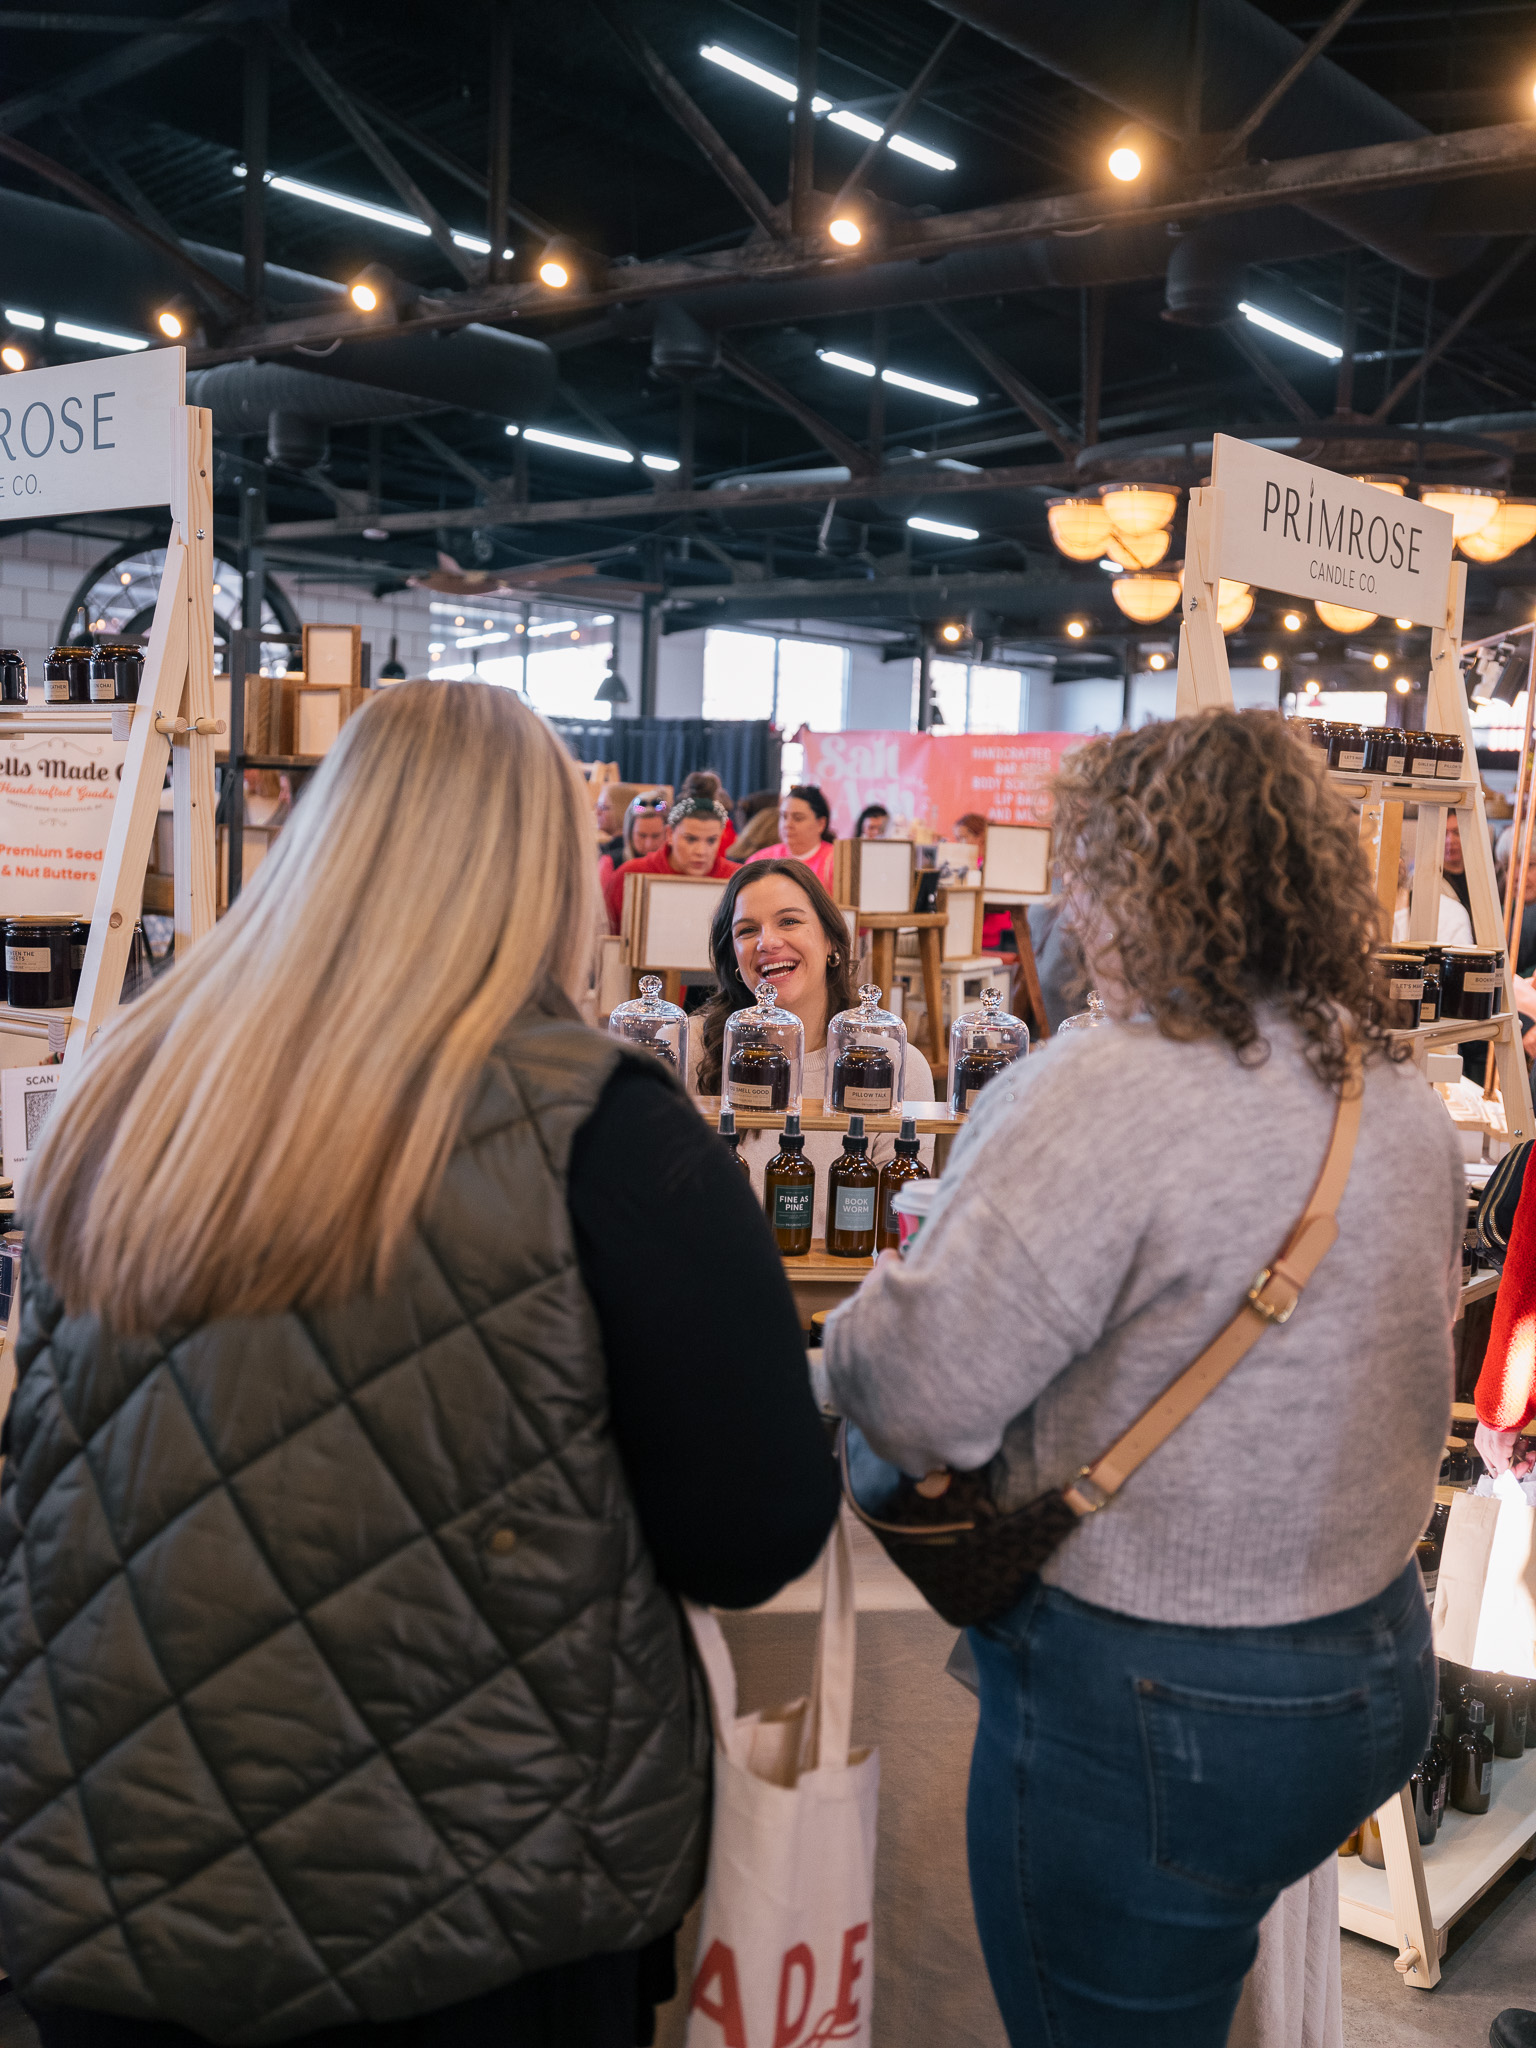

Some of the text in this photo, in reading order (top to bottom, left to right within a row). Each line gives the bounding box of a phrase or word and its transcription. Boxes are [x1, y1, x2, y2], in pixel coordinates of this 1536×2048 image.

[12, 473, 42, 496] CO.
[1263, 478, 1422, 574] PRIMROSE
[1309, 560, 1378, 594] CANDLE CO.
[816, 735, 898, 780] Salt
[37, 758, 109, 781] Made
[76, 785, 114, 802] Goods
[0, 844, 104, 861] Premium Seed
[1, 865, 97, 881] & Nut Butters
[26, 1075, 54, 1086] SCAN
[779, 1195, 809, 1204] FINE AS
[785, 1203, 804, 1211] PINE
[844, 1197, 868, 1206] BOOK
[842, 1205, 869, 1213] WORM
